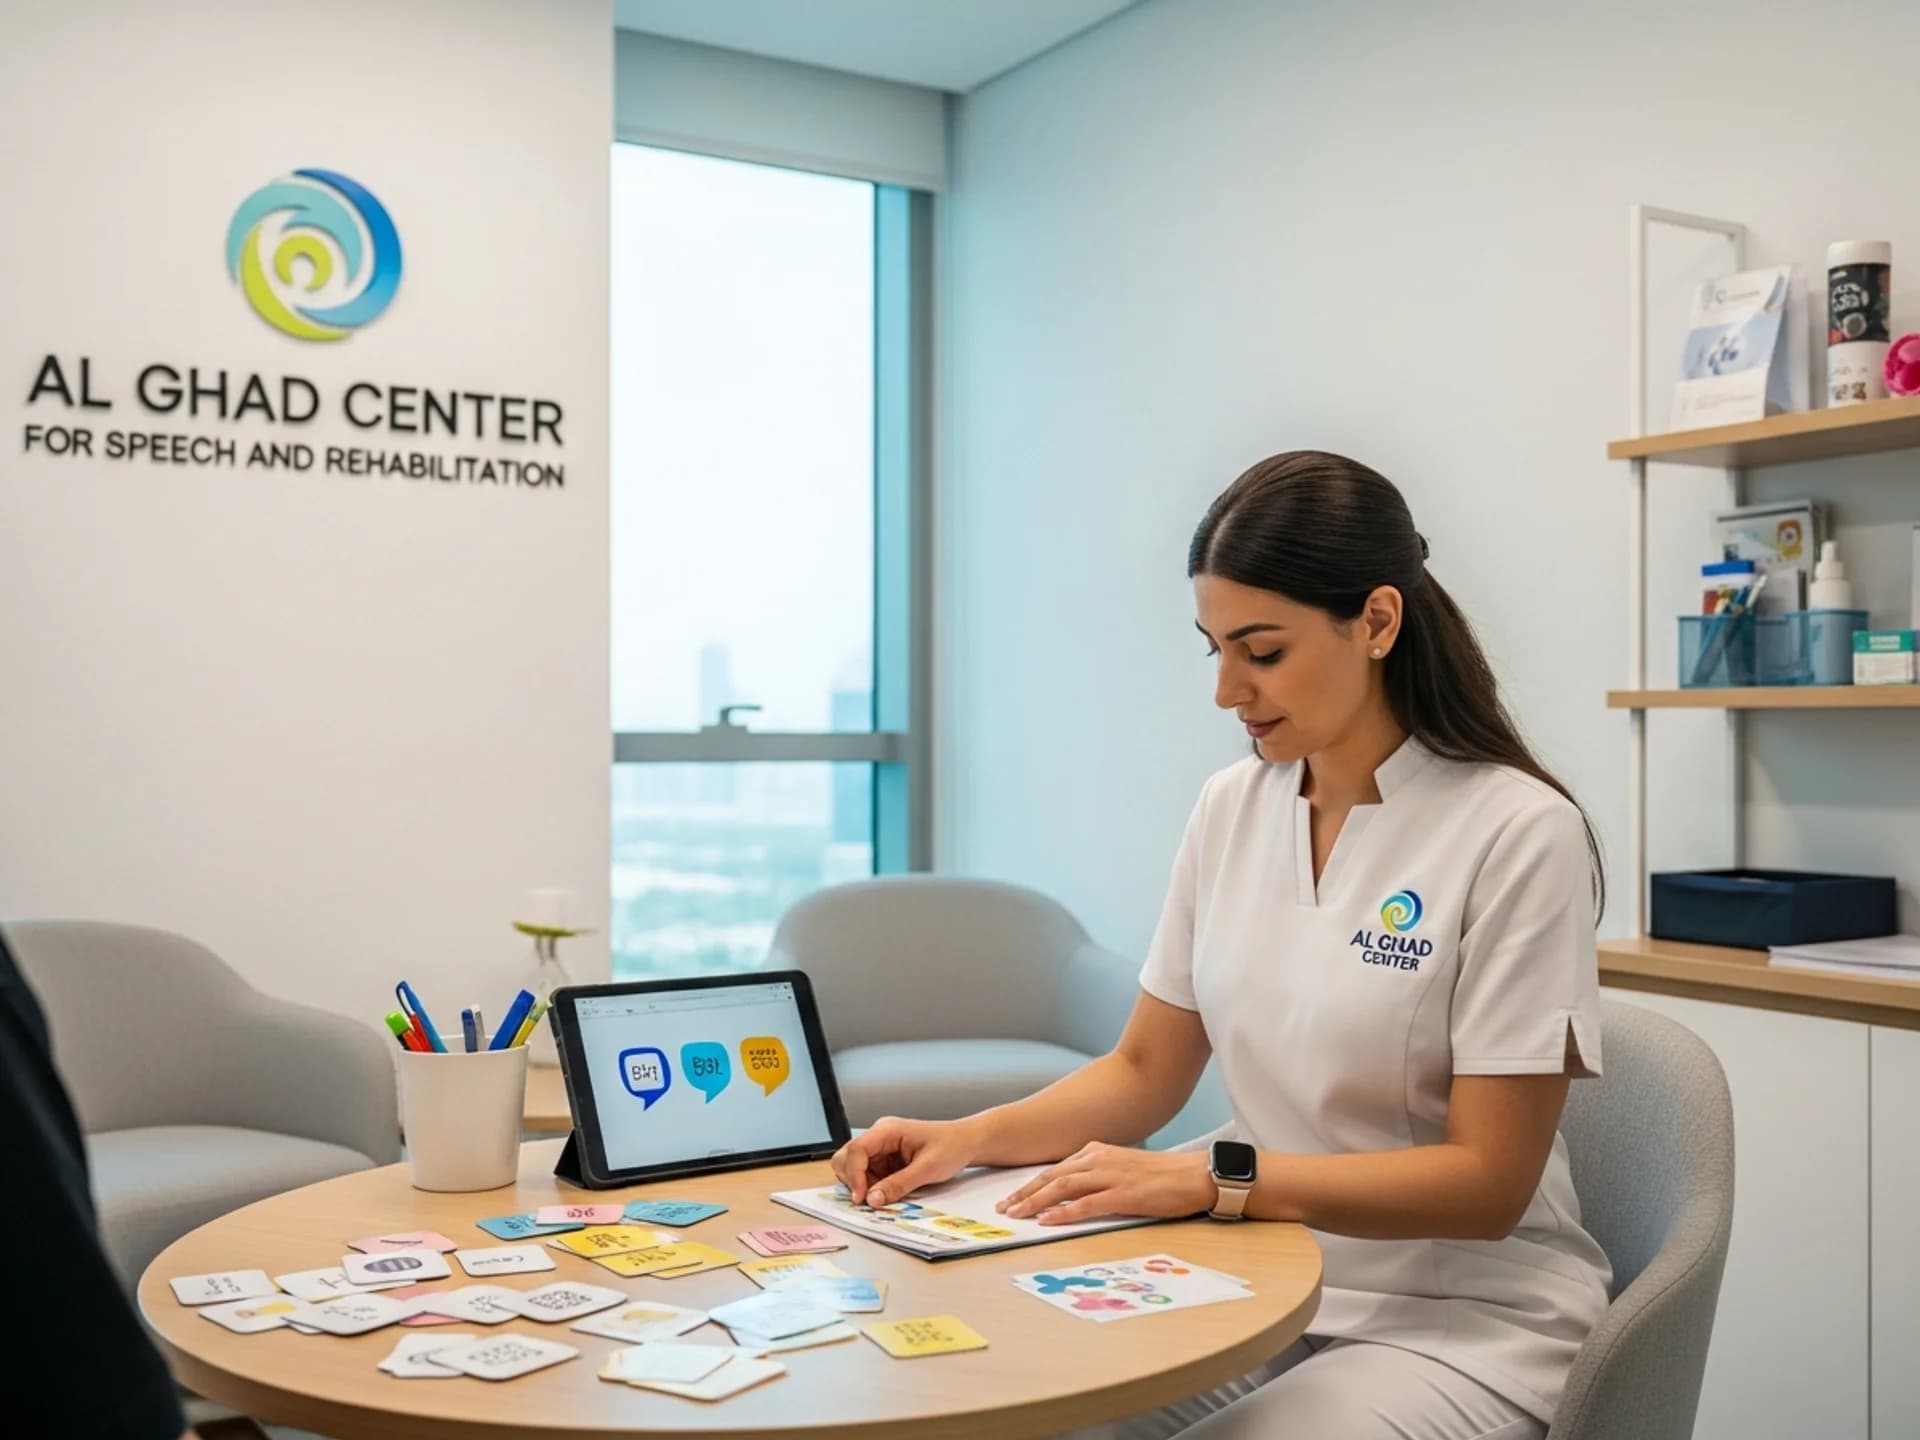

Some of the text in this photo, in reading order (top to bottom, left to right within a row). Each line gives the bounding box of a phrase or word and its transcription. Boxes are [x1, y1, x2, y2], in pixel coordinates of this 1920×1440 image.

[26, 353, 564, 446] AL GHAD CENTER
[25, 424, 564, 487] FOR SPEECH AND REHABILITATION
[1350, 929, 1375, 949] AL
